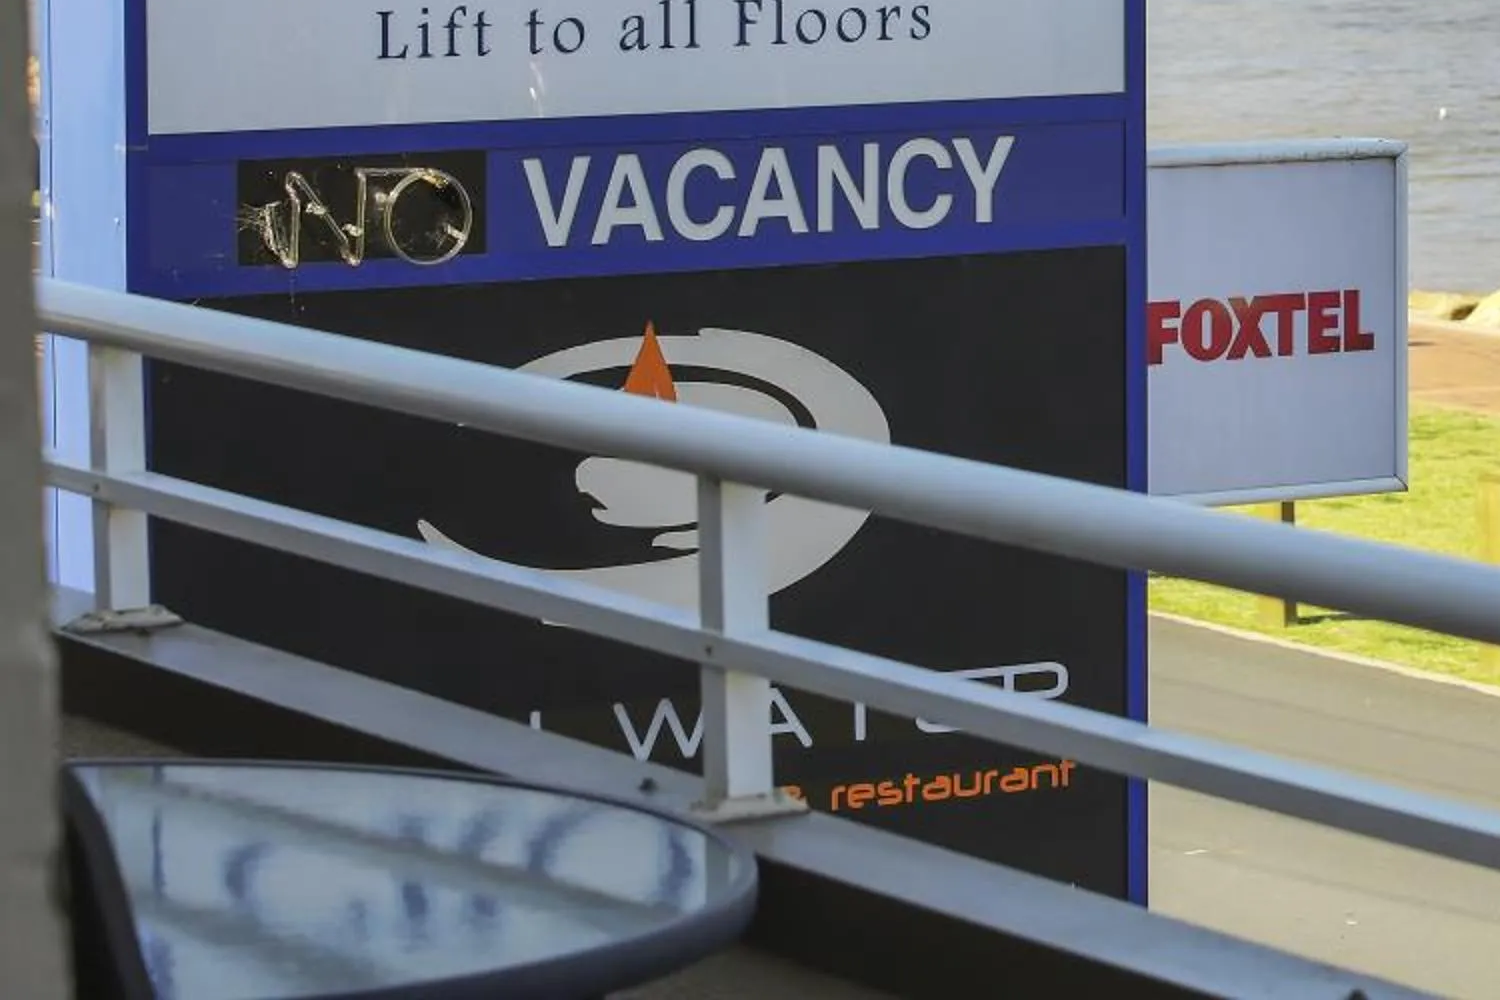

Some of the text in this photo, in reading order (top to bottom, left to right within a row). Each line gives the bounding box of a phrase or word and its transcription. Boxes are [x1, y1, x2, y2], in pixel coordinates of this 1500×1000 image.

[375, 5, 492, 61] Lift
[525, 6, 586, 56] to
[260, 134, 1015, 269] NO VACANCY
[1147, 289, 1375, 367] FOXTEL
[830, 758, 1077, 812] restaurant
